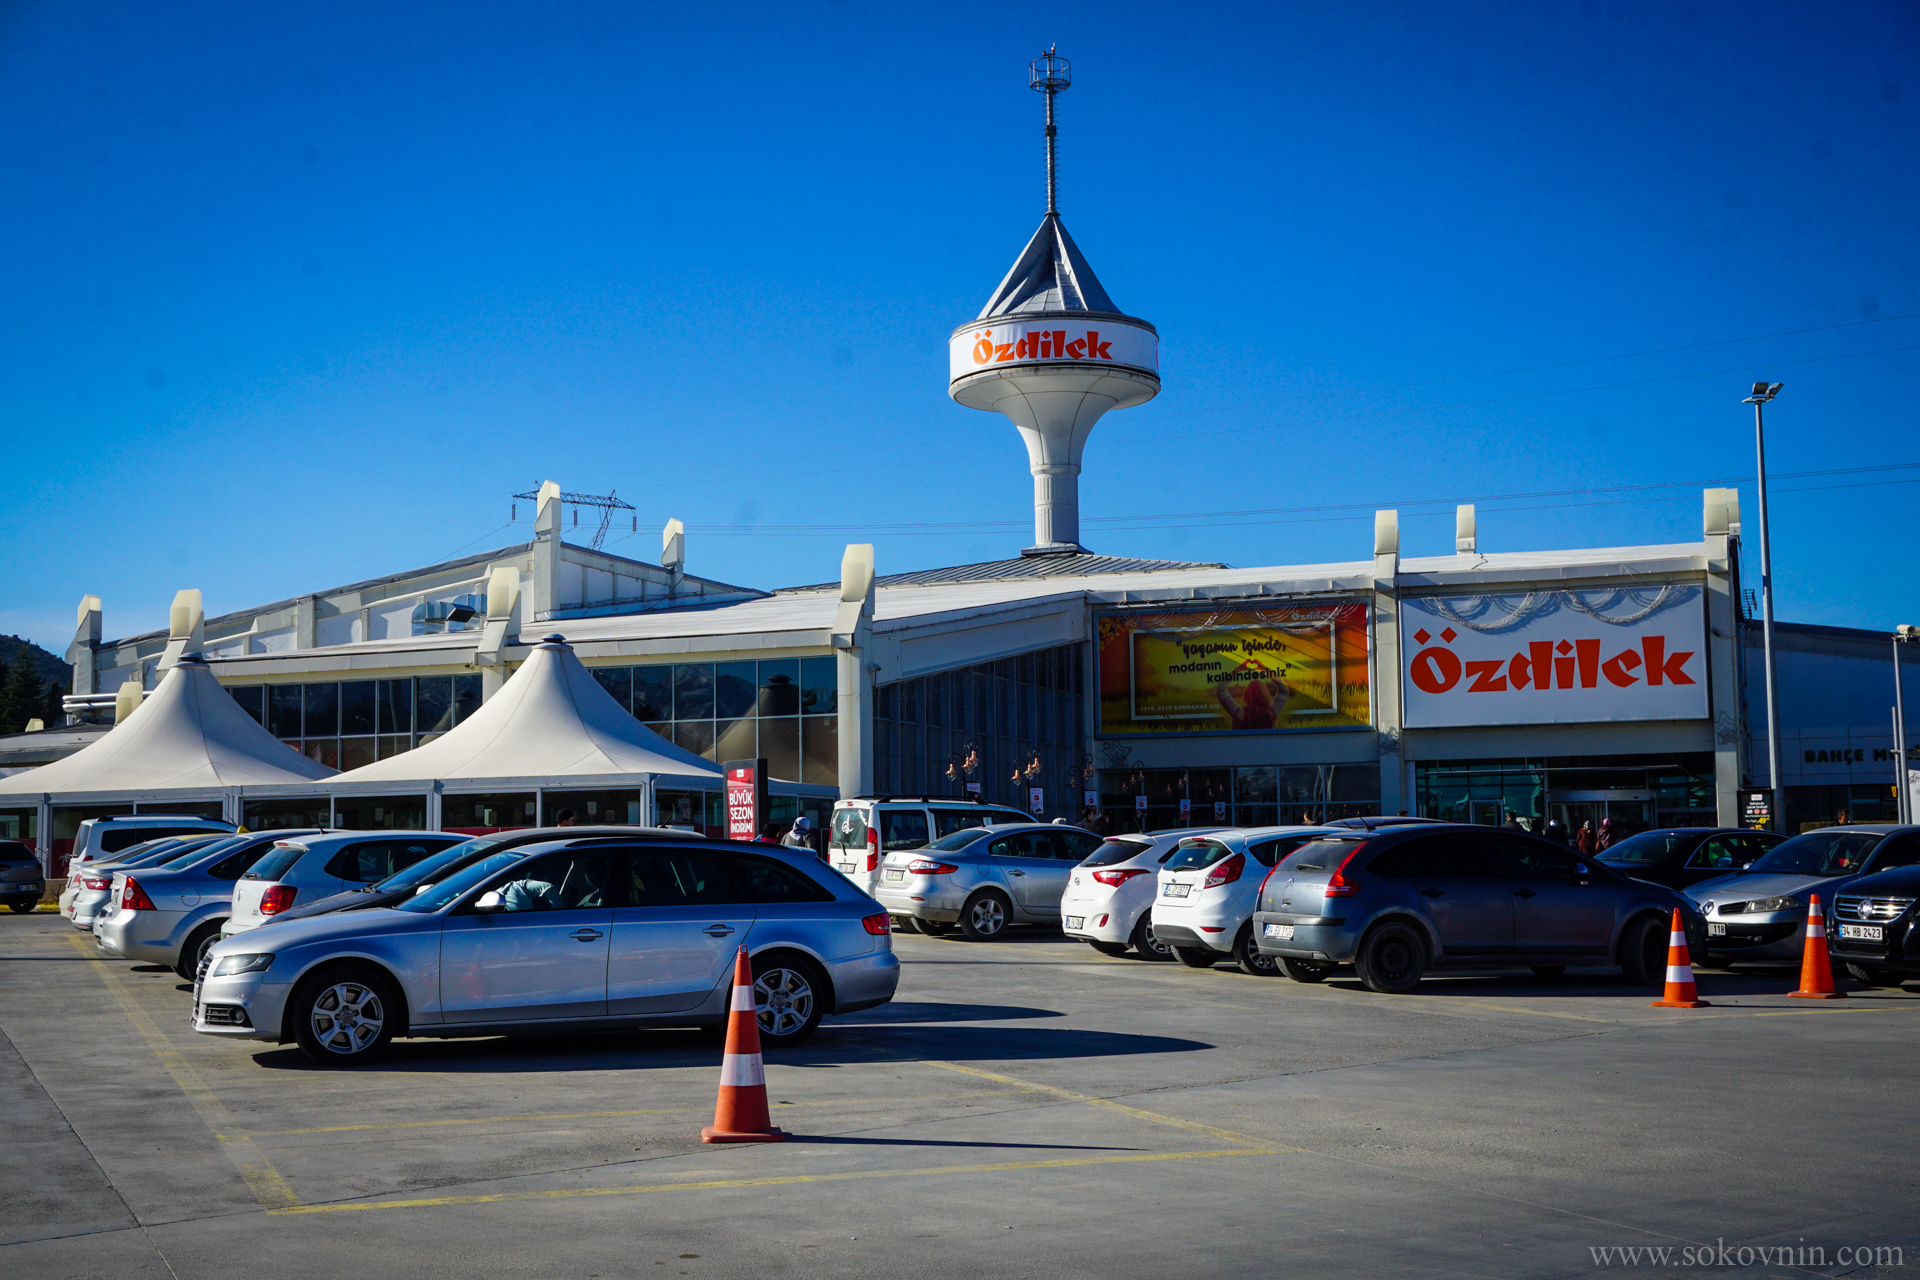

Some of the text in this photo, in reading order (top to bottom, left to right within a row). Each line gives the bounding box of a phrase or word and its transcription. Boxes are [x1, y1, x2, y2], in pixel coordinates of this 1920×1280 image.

[972, 329, 1113, 365] Özdilek
[1169, 661, 1222, 674] modanın
[1410, 626, 1697, 694] Özdilek
[1805, 749, 1863, 765] BAHÇE
[729, 789, 753, 806] BÜYÜK
[730, 806, 754, 820] SEZON
[1714, 925, 1725, 934] 118
[1842, 926, 1881, 938] 34 HB 2423
